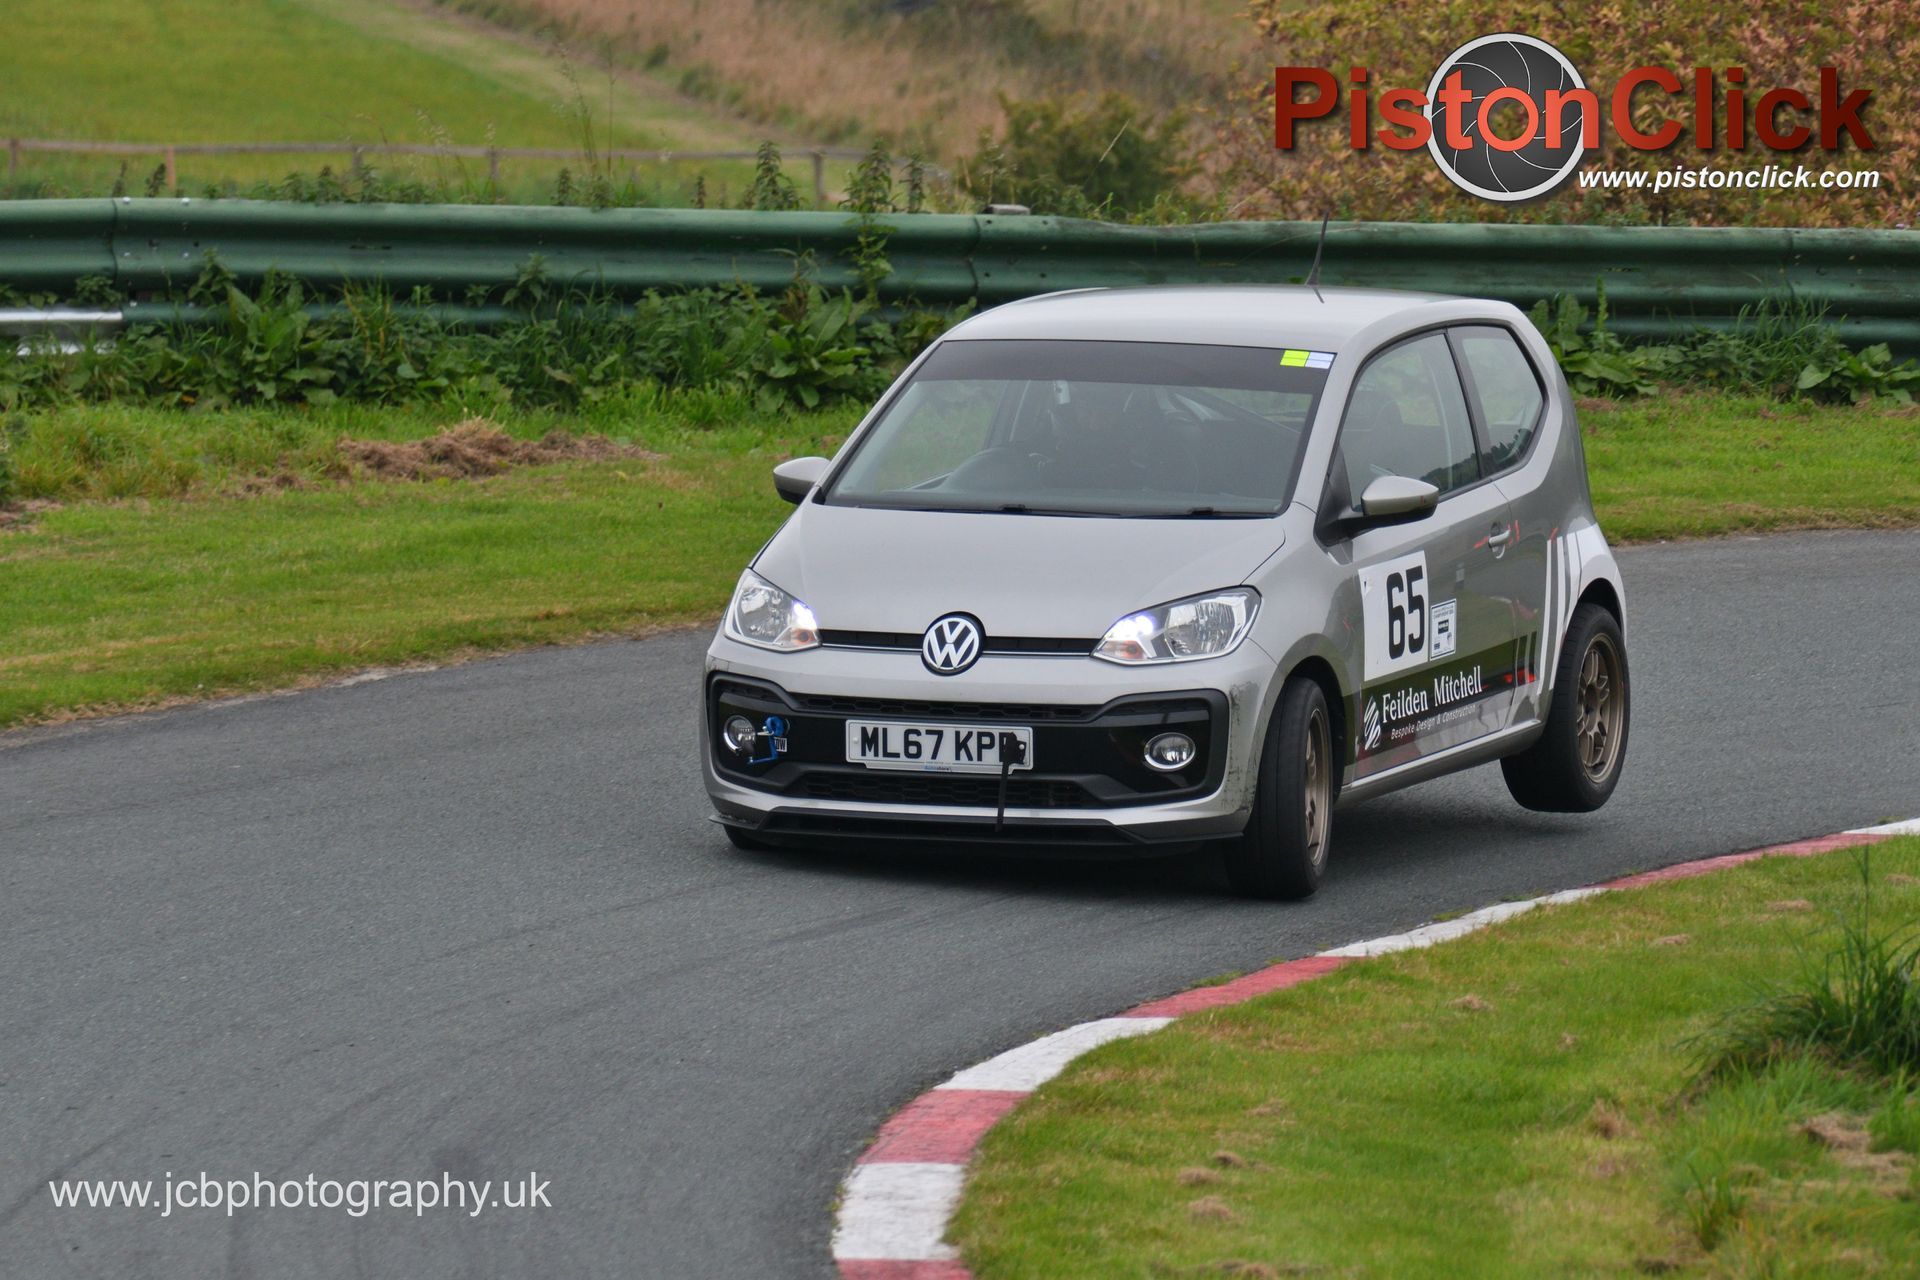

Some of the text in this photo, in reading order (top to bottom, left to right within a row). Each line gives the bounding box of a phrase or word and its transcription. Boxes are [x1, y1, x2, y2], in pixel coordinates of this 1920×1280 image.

[1386, 565, 1425, 660] 65
[1382, 665, 1483, 723] Feilden Mitchell
[860, 726, 944, 760] ML67
[1390, 723, 1415, 740] Bespoke
[1415, 717, 1435, 732] Design
[1442, 704, 1477, 723] Construction
